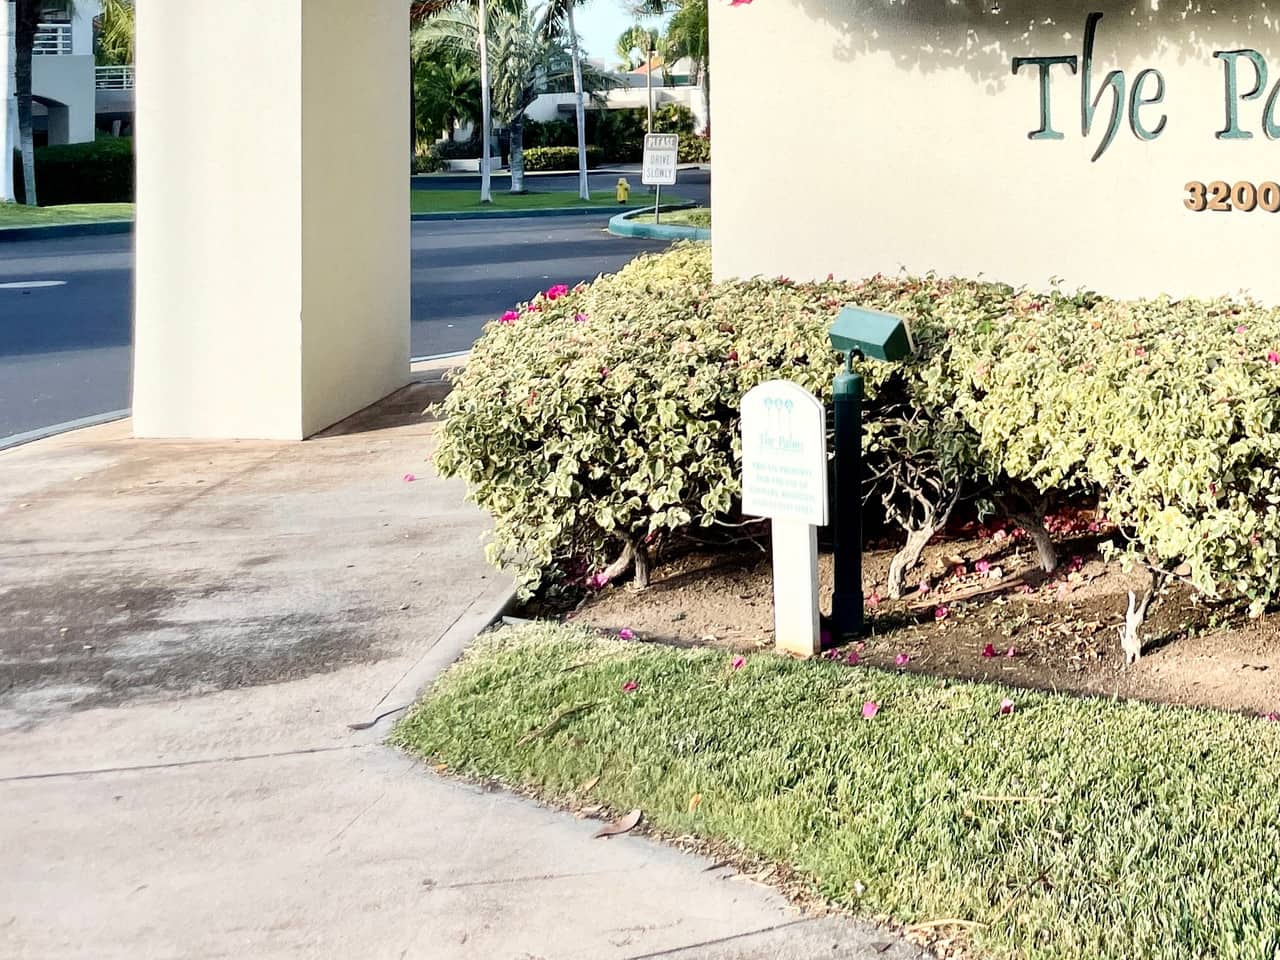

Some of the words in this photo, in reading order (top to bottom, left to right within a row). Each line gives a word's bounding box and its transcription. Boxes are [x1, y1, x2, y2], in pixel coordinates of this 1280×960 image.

[1011, 11, 1168, 163] The
[647, 136, 675, 147] PLEASE
[650, 154, 670, 165] DRIVE
[646, 167, 672, 178] SLOWLY
